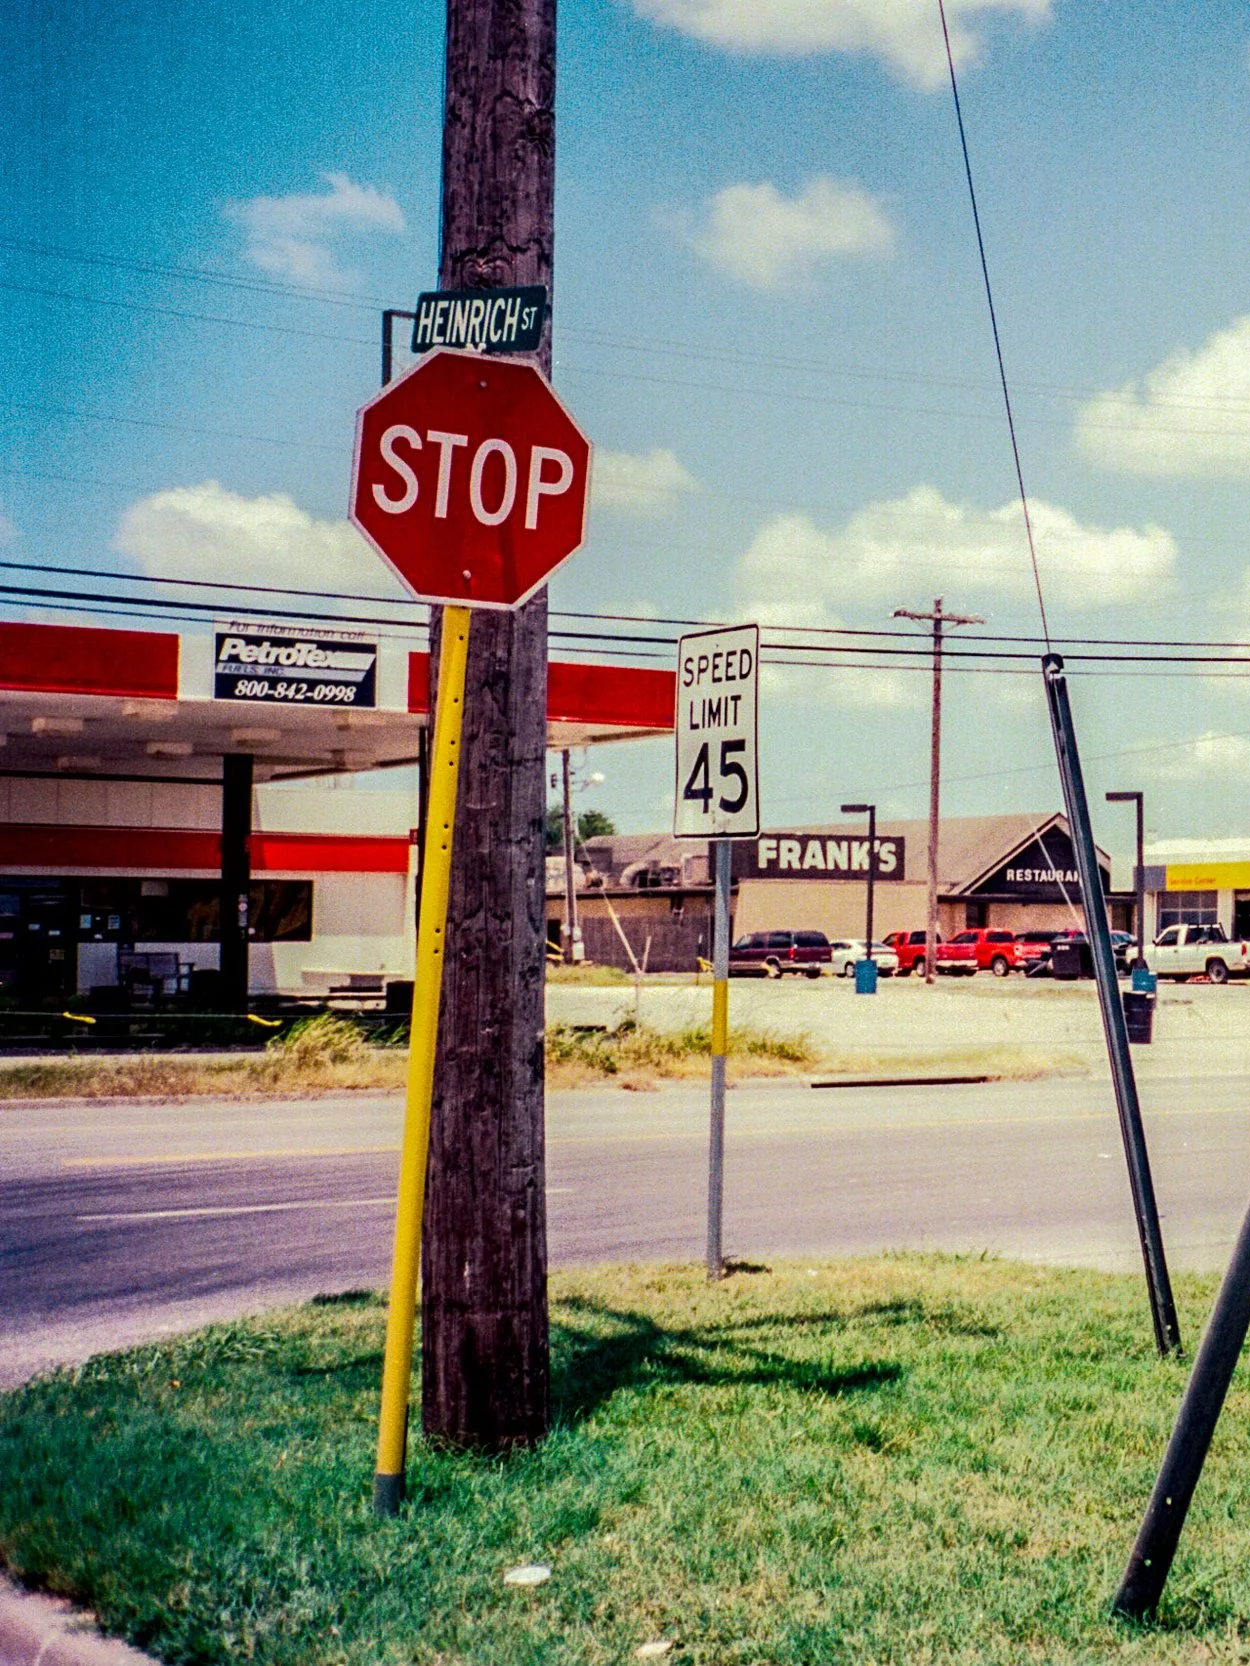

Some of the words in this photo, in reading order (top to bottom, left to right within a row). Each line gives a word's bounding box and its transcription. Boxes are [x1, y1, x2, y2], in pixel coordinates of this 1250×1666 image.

[416, 298, 521, 344] HEINRICH
[521, 306, 538, 331] ST
[372, 424, 574, 530] STOP
[219, 637, 342, 668] PetroTex
[683, 648, 753, 687] SPEED
[234, 679, 357, 703] 800-842-0998
[690, 695, 742, 730] LIMIT
[683, 739, 749, 814] 45
[758, 838, 897, 873] FRANK'S
